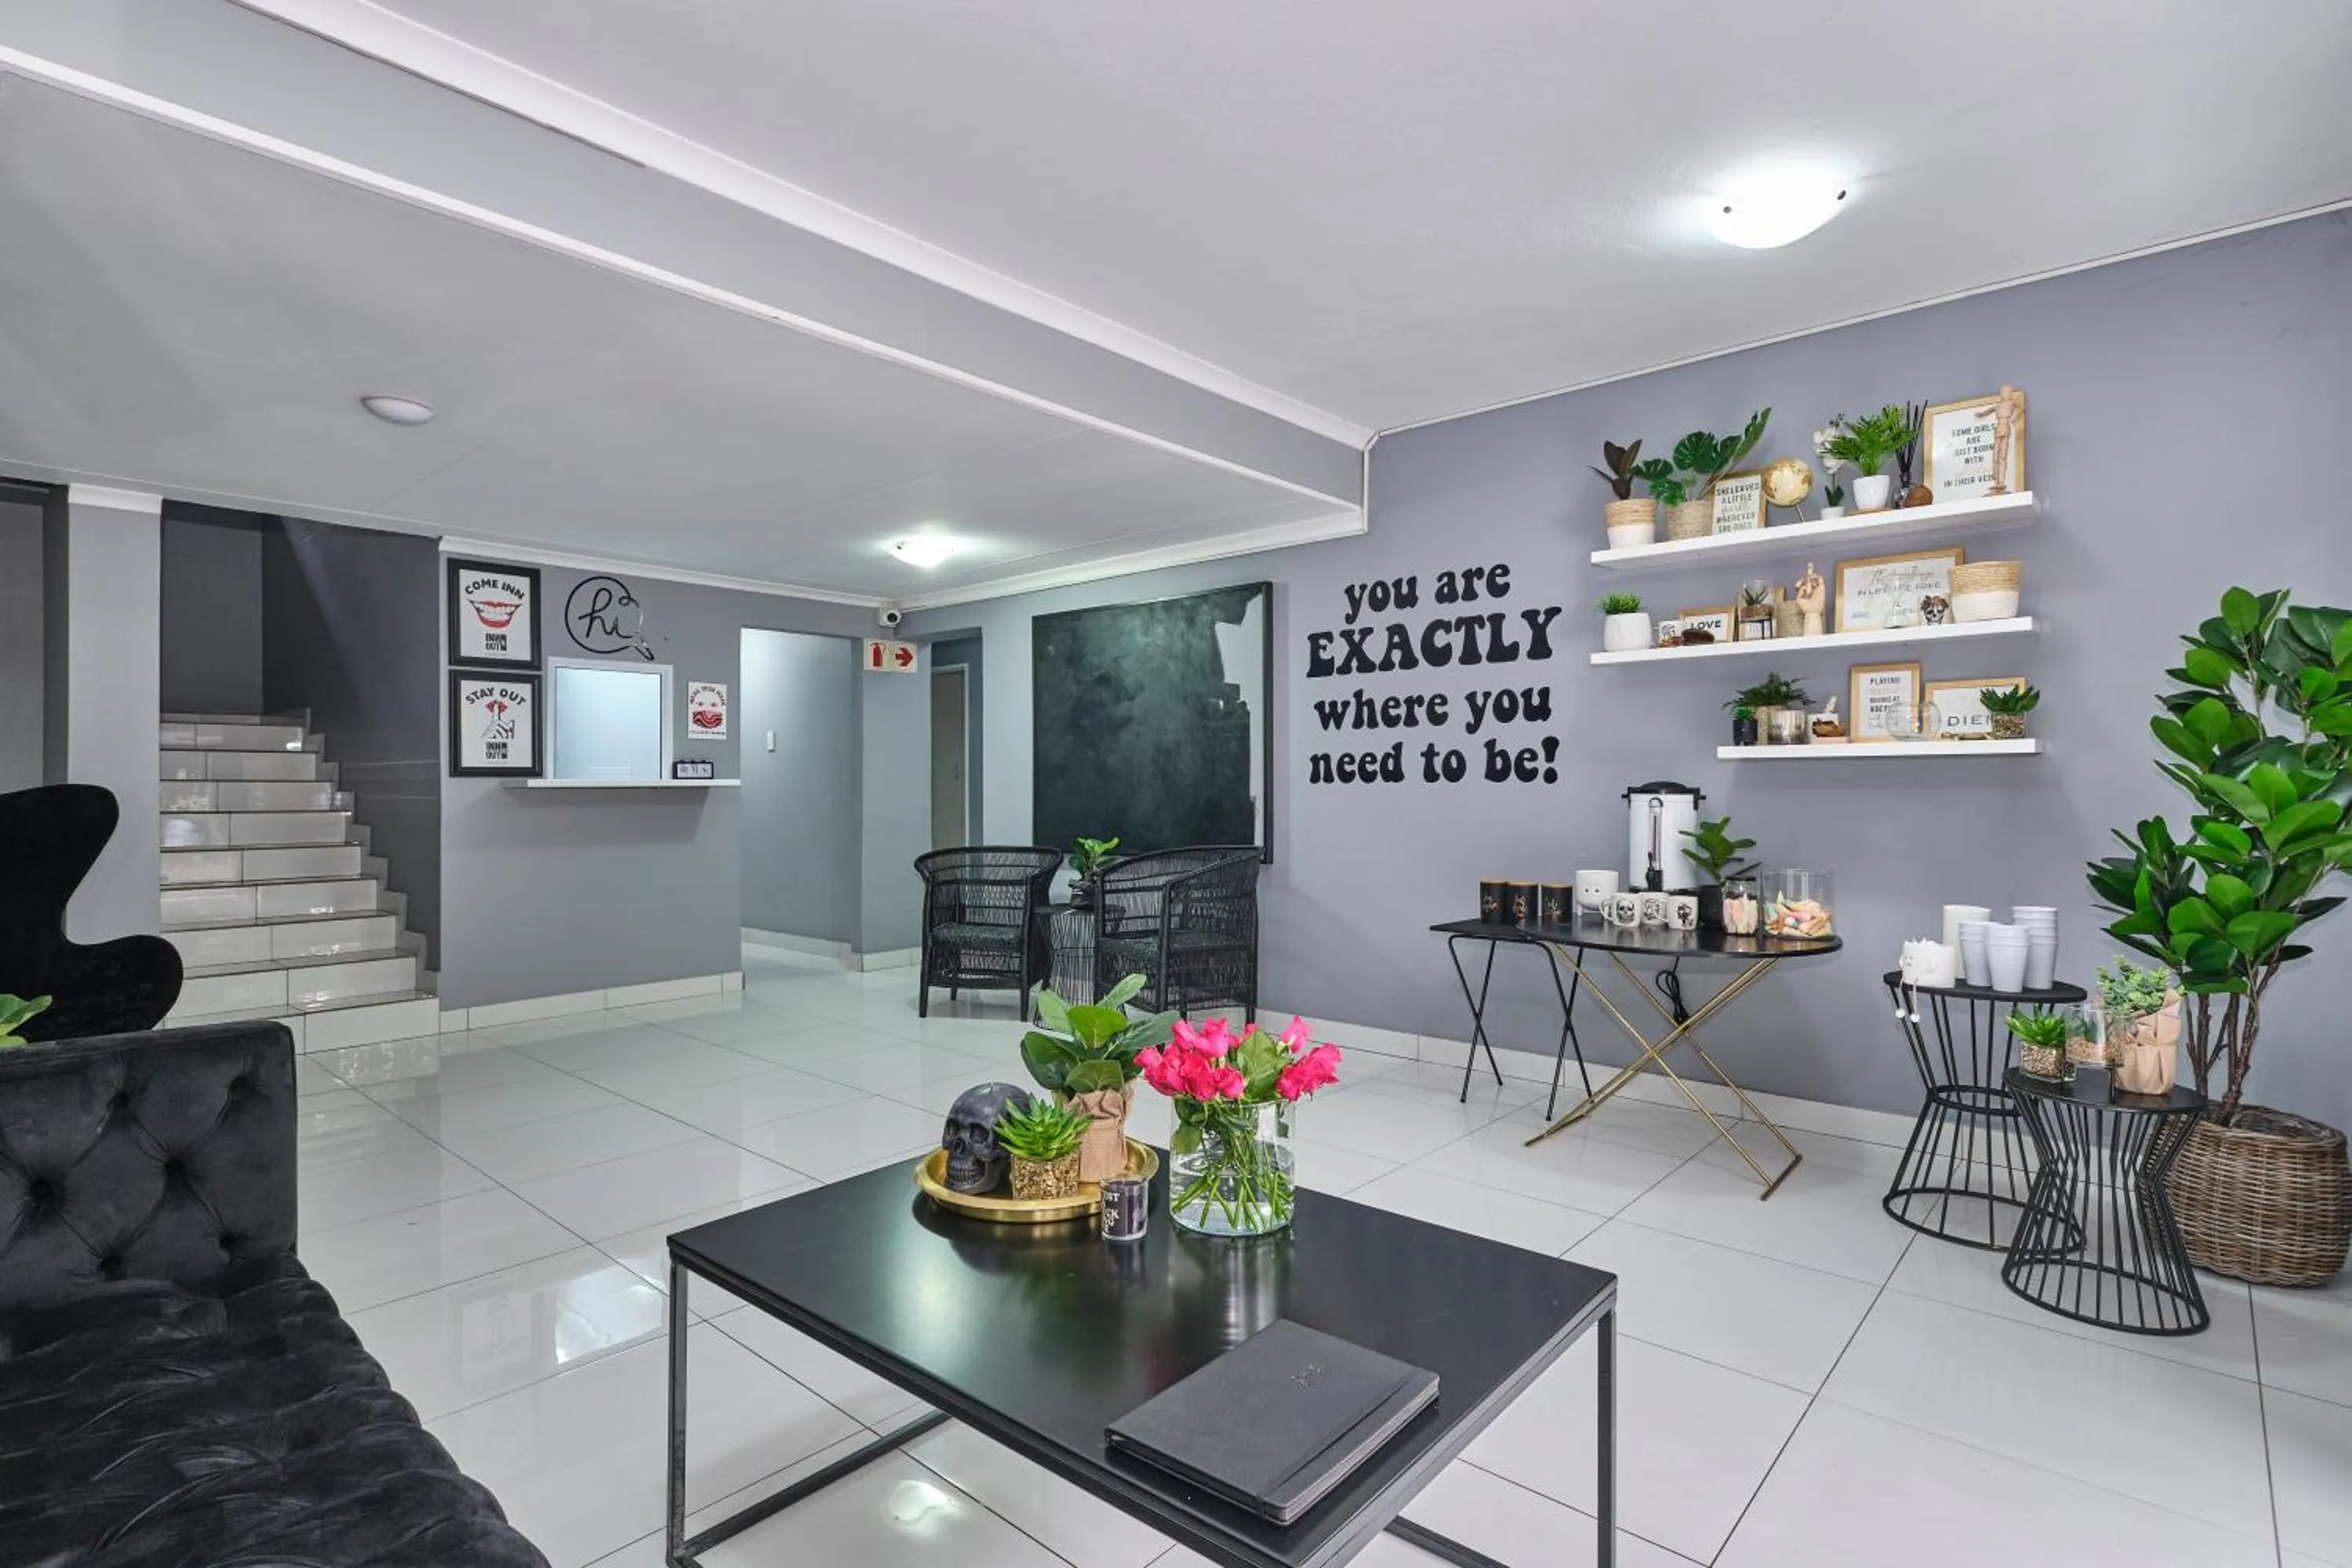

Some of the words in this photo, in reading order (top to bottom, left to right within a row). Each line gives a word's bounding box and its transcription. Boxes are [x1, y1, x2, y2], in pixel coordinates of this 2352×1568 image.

[465, 579, 499, 595] COME
[502, 582, 524, 600] INN
[1344, 575, 1418, 625] you
[1434, 564, 1511, 604] are
[1306, 606, 1563, 678] EXACTLY
[1691, 619, 1722, 630] LOVE
[465, 687, 495, 705] STAY
[499, 688, 527, 706] OUT
[1313, 688, 1450, 731] where
[1465, 686, 1552, 735] you
[1309, 741, 1406, 785] need
[1420, 742, 1467, 783] to
[1483, 735, 1560, 785] be!
